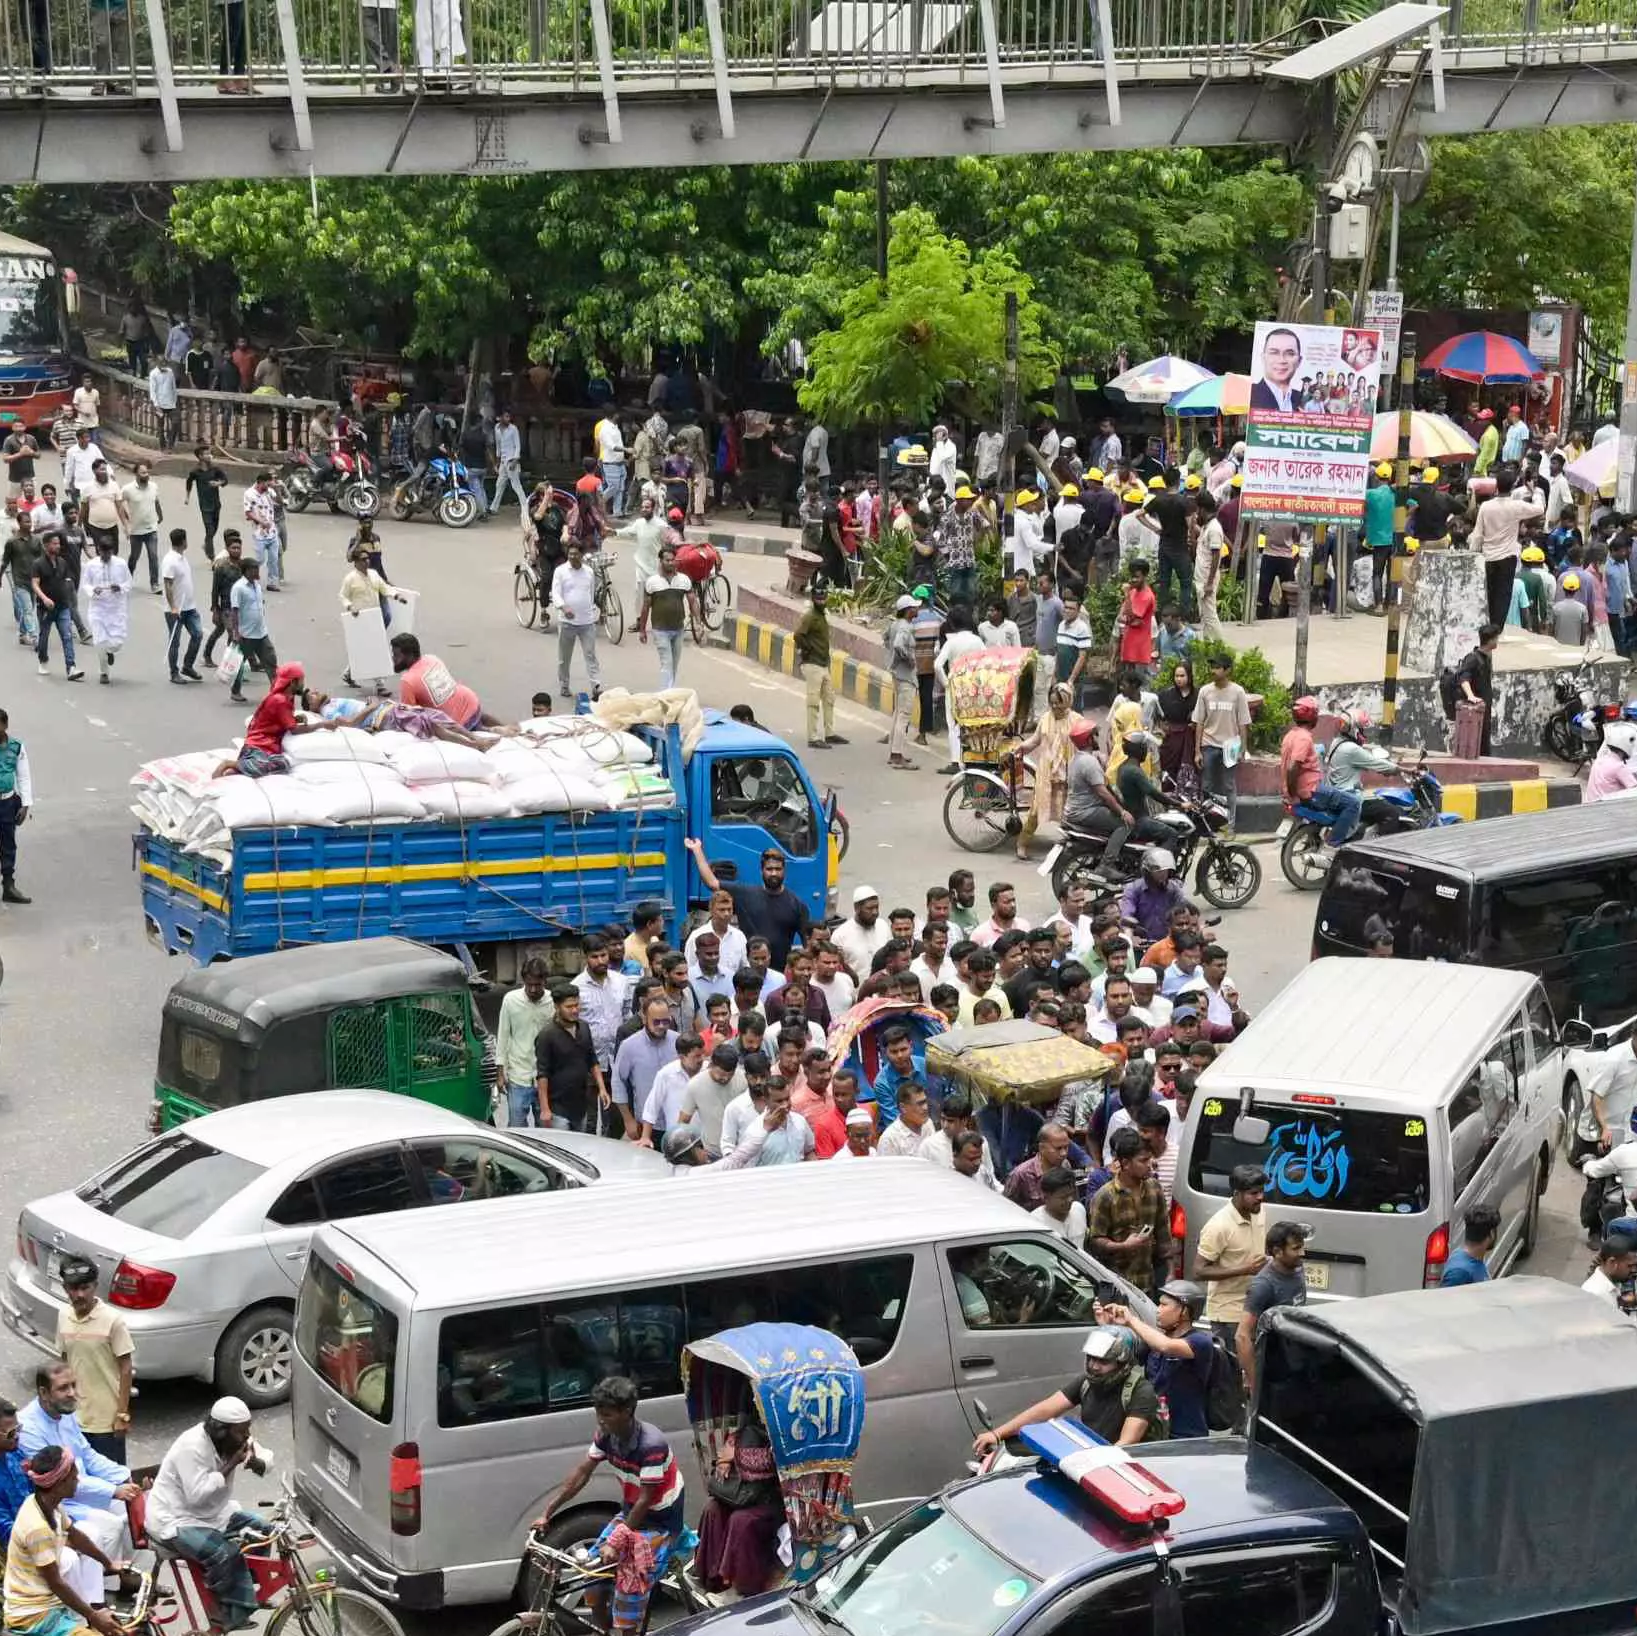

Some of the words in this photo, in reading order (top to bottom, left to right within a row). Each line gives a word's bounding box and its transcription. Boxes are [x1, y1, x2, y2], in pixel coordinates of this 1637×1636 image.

[1256, 429, 1366, 451] সমাবেশ
[1248, 457, 1280, 477] জনাব
[1284, 460, 1325, 480] তারেক
[1328, 463, 1367, 481] রহমান
